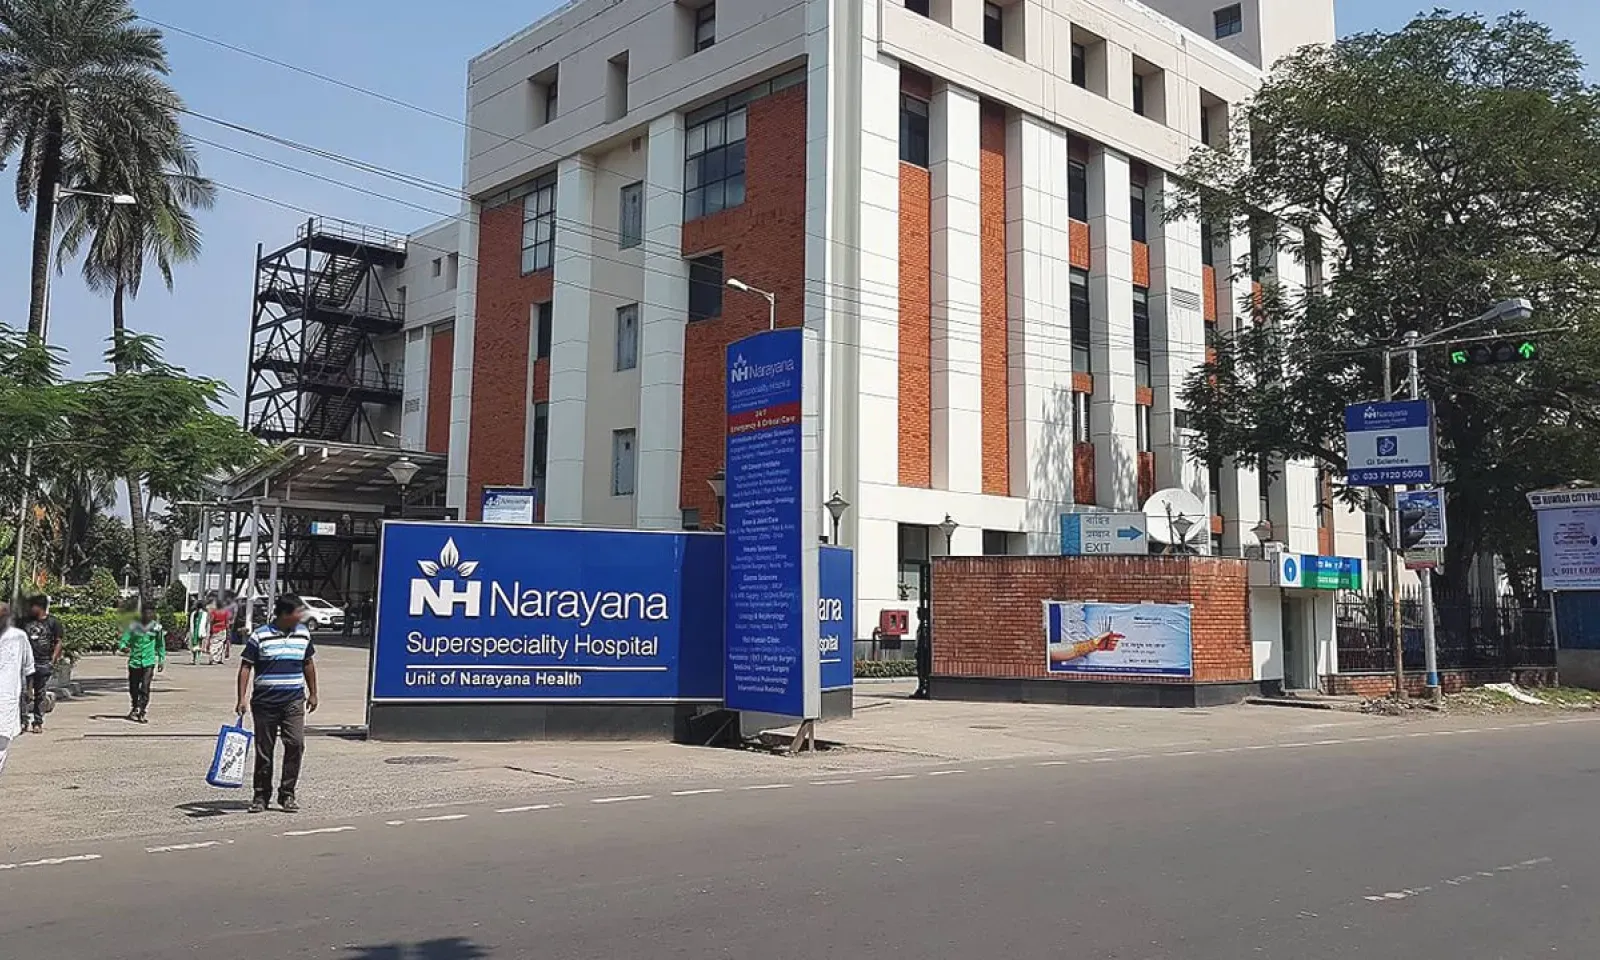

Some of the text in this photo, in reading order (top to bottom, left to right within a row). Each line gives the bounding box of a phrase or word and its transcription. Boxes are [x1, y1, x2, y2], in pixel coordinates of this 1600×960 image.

[731, 359, 795, 383] NH Narayana
[1085, 542, 1110, 553] EXIT
[409, 578, 669, 627] NH Narayana
[406, 631, 659, 660] Superspeciality Hospital
[405, 671, 582, 689] Unit of Narayana Health
